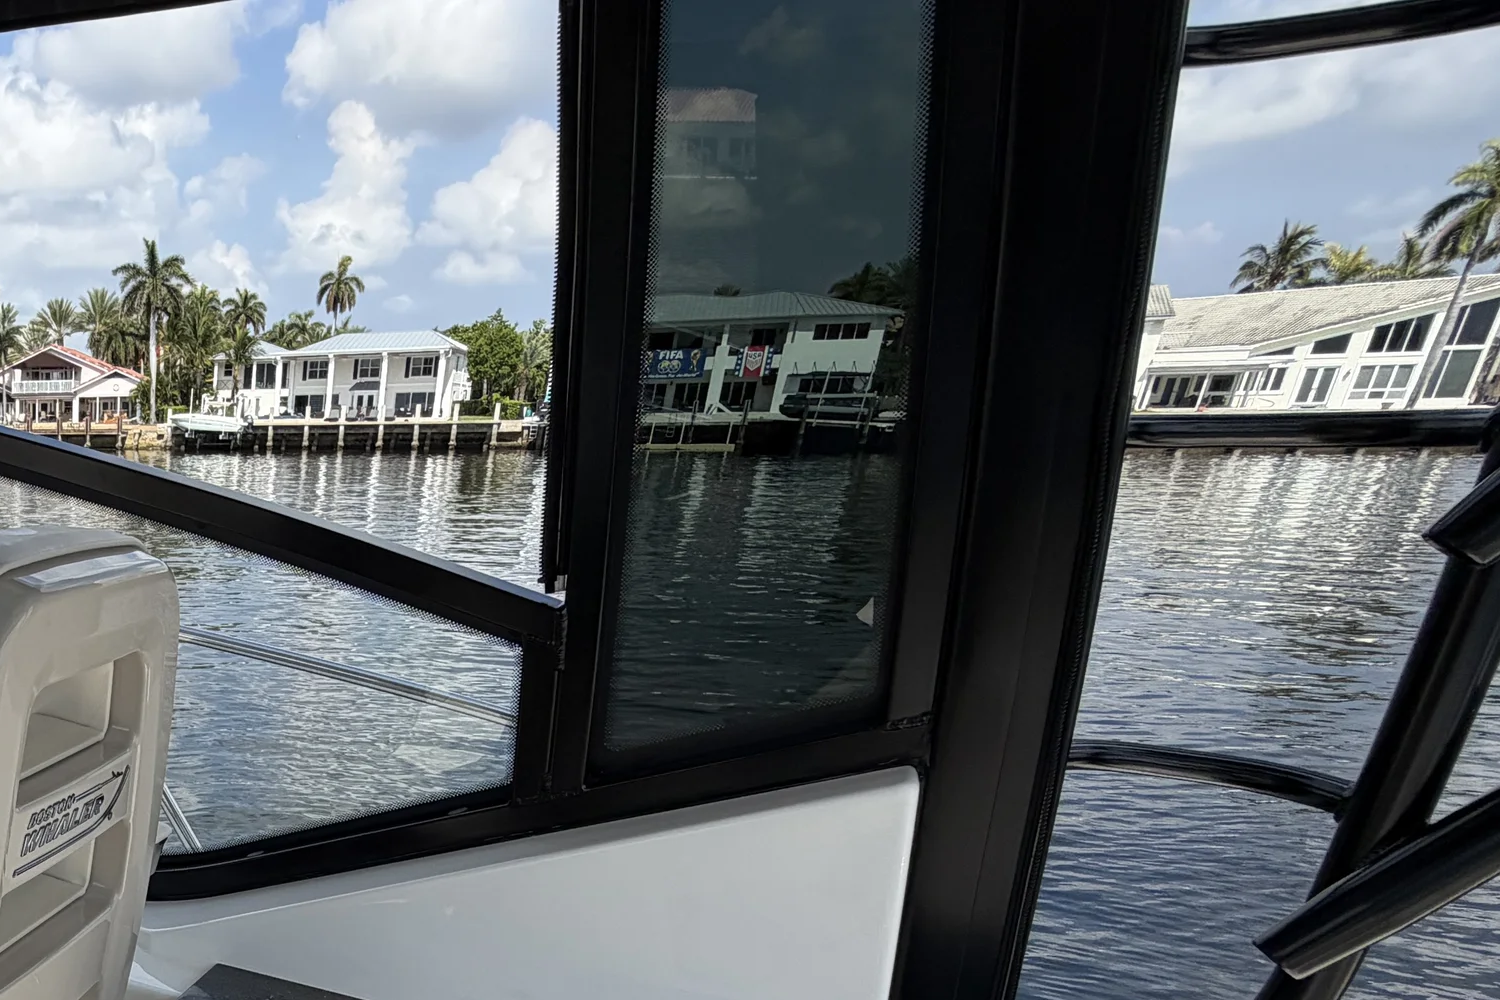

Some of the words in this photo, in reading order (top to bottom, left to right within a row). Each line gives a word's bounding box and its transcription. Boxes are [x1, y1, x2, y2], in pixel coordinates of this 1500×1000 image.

[658, 349, 684, 360] FIFA
[748, 351, 762, 360] USA
[27, 793, 76, 830] BOSTON
[20, 793, 105, 857] WHALER
